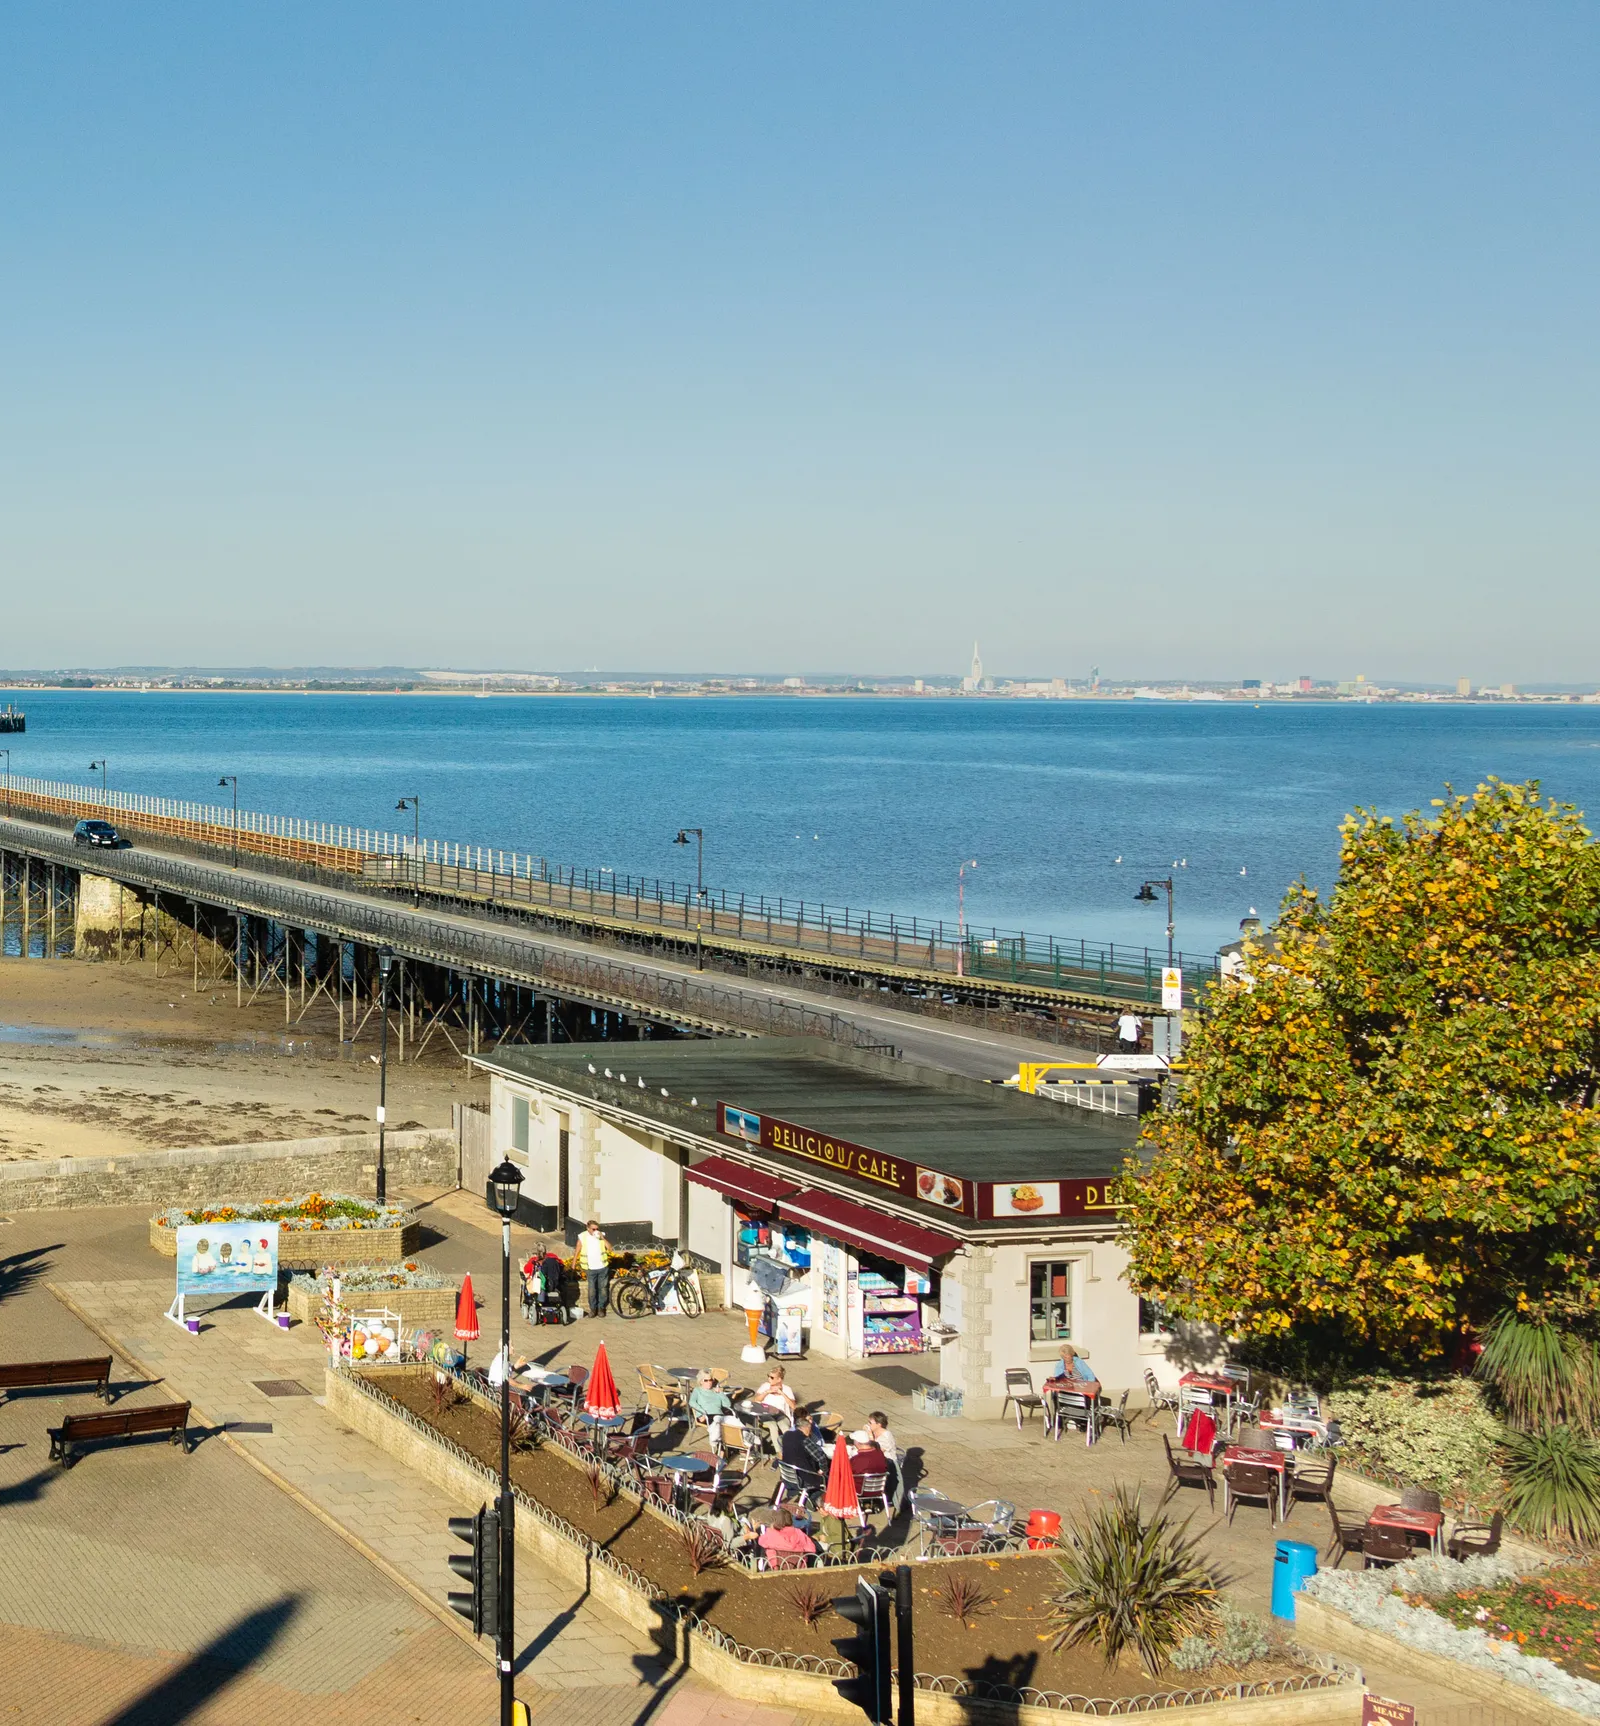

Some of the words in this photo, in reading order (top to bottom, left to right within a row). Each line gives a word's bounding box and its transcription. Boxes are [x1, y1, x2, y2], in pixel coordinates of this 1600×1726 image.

[773, 1125, 854, 1168] DELICIOUS
[858, 1154, 897, 1181] CAFE
[1372, 1704, 1405, 1720] MEALS
